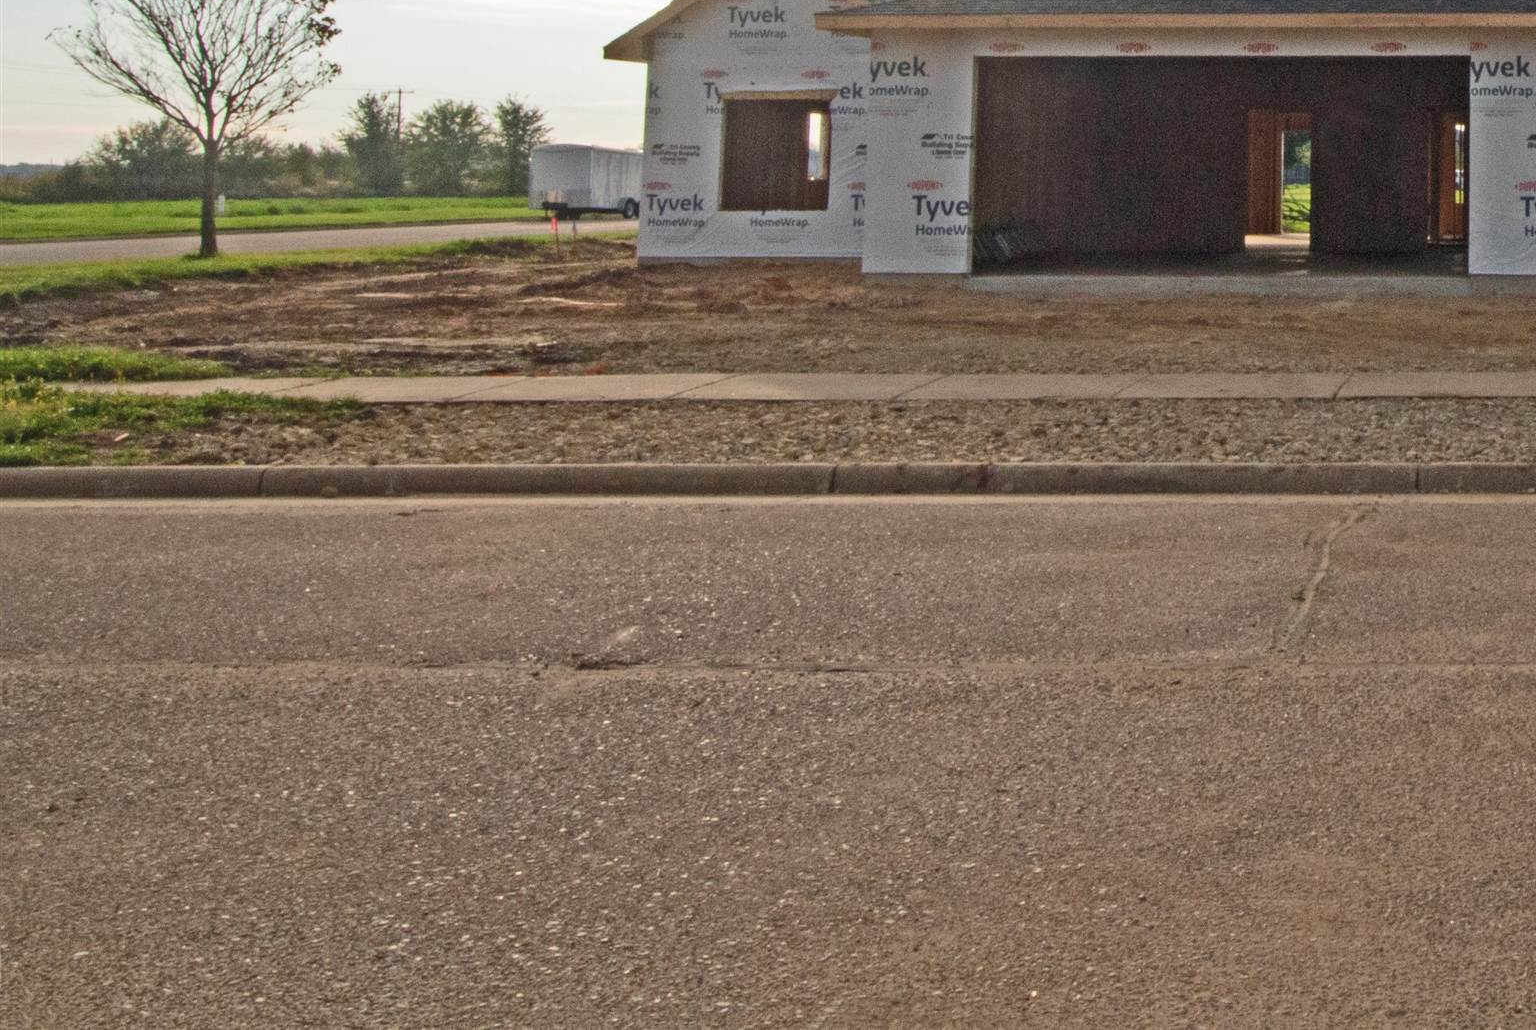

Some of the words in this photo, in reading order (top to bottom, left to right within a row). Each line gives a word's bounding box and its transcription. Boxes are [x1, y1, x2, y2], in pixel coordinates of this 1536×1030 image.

[727, 5, 786, 28] Tyvek
[729, 29, 787, 40] HomeWrap
[646, 194, 704, 216] Tyvek
[648, 218, 705, 229] HomeWrap
[751, 218, 807, 229] HomeWrap
